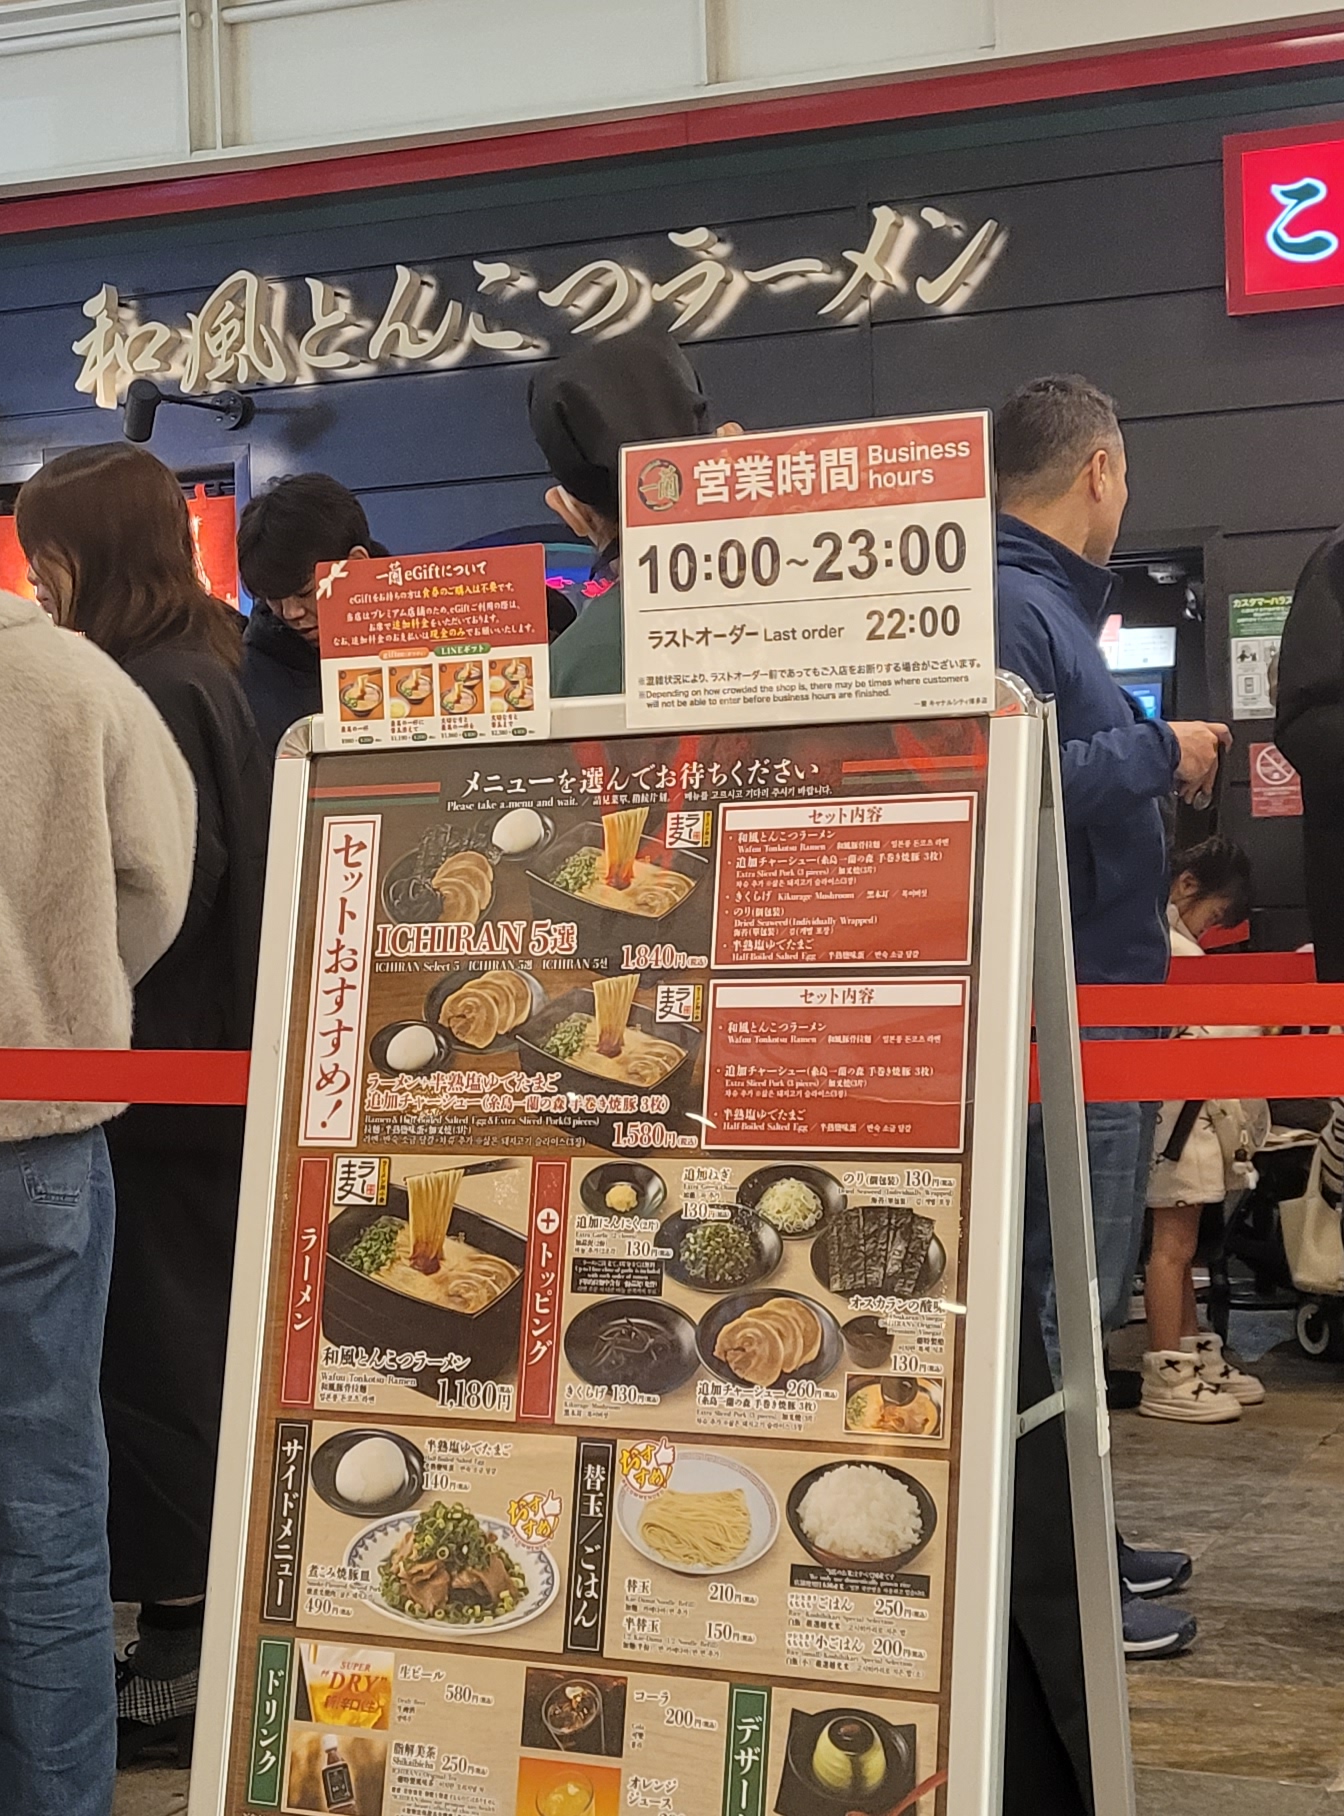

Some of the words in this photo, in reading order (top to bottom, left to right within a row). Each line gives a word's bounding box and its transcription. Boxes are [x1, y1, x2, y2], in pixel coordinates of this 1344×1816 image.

[74, 205, 1006, 411] 和風とんこつラーメン
[868, 439, 970, 466] Business
[693, 447, 859, 505] 営業時間
[868, 466, 934, 489] hours
[648, 624, 759, 649] ラストオーダー
[763, 627, 797, 642] Last
[801, 625, 845, 641] order
[865, 604, 961, 641] 22:00
[704, 688, 720, 697] how
[722, 686, 757, 695] crowded
[760, 685, 774, 693] the
[776, 684, 797, 694] shop
[810, 682, 832, 690] there
[835, 682, 853, 691] may
[855, 679, 866, 688] be
[868, 678, 892, 687] times
[894, 677, 921, 686] where
[923, 674, 969, 684] customers
[647, 701, 660, 709] will
[661, 700, 675, 708] not
[677, 699, 688, 707] be
[690, 698, 706, 707] able
[719, 697, 740, 705] enter
[743, 695, 771, 704] before
[773, 692, 810, 702] business
[812, 691, 836, 700] hours
[838, 691, 853, 699] are
[855, 688, 891, 698] finished.
[461, 759, 819, 798] メニューを選んでお待ちください
[447, 801, 475, 811] Please
[477, 799, 497, 810] take
[537, 796, 554, 807] and
[557, 795, 578, 806] wait.
[809, 806, 883, 824] セット内容
[738, 830, 836, 844] 和風とんこつラーメン
[815, 891, 855, 900] Mushroom
[734, 919, 755, 928] Dried
[376, 921, 527, 957] ICHIRAN
[529, 919, 577, 954] 5選
[733, 938, 814, 951] 半熟塩ゆでたまご
[801, 952, 817, 961] Egg
[375, 960, 420, 973] ICHIRAN
[423, 960, 451, 972] Select
[453, 960, 460, 971] 5
[468, 959, 515, 971] ICHIRAN
[543, 959, 590, 970] ICHIRAN
[800, 987, 875, 1005] セット内容
[727, 1021, 827, 1034] 和風とんこつラーメン
[790, 1035, 816, 1043] Ramen
[723, 1109, 807, 1121] 半熟塩ゆでたまご
[683, 1167, 731, 1182] 追加ねぎ
[293, 1228, 318, 1332] ラーメン
[527, 1242, 557, 1366] トッピング
[322, 1347, 471, 1371] 和風とんこつラーメン
[387, 1376, 417, 1386] Ramen
[698, 1382, 784, 1397] 追加チャーシュー
[565, 1385, 606, 1399] きくらげ
[425, 1439, 513, 1459] 半熟塩ゆでたまご
[274, 1439, 304, 1606] サイドメニュー
[626, 1578, 651, 1594] 替玉
[818, 1597, 854, 1612] ごはん
[625, 1616, 660, 1633] 半替玉
[815, 1635, 863, 1652] 小ごはん
[340, 1661, 371, 1672] SUPER
[398, 1665, 444, 1682] 生ビール
[634, 1691, 670, 1706] コーラ
[256, 1668, 285, 1776] ドリンク
[733, 1715, 763, 1816] デザー
[629, 1776, 677, 1794] オレンジ
[628, 1792, 672, 1810] ジュース
